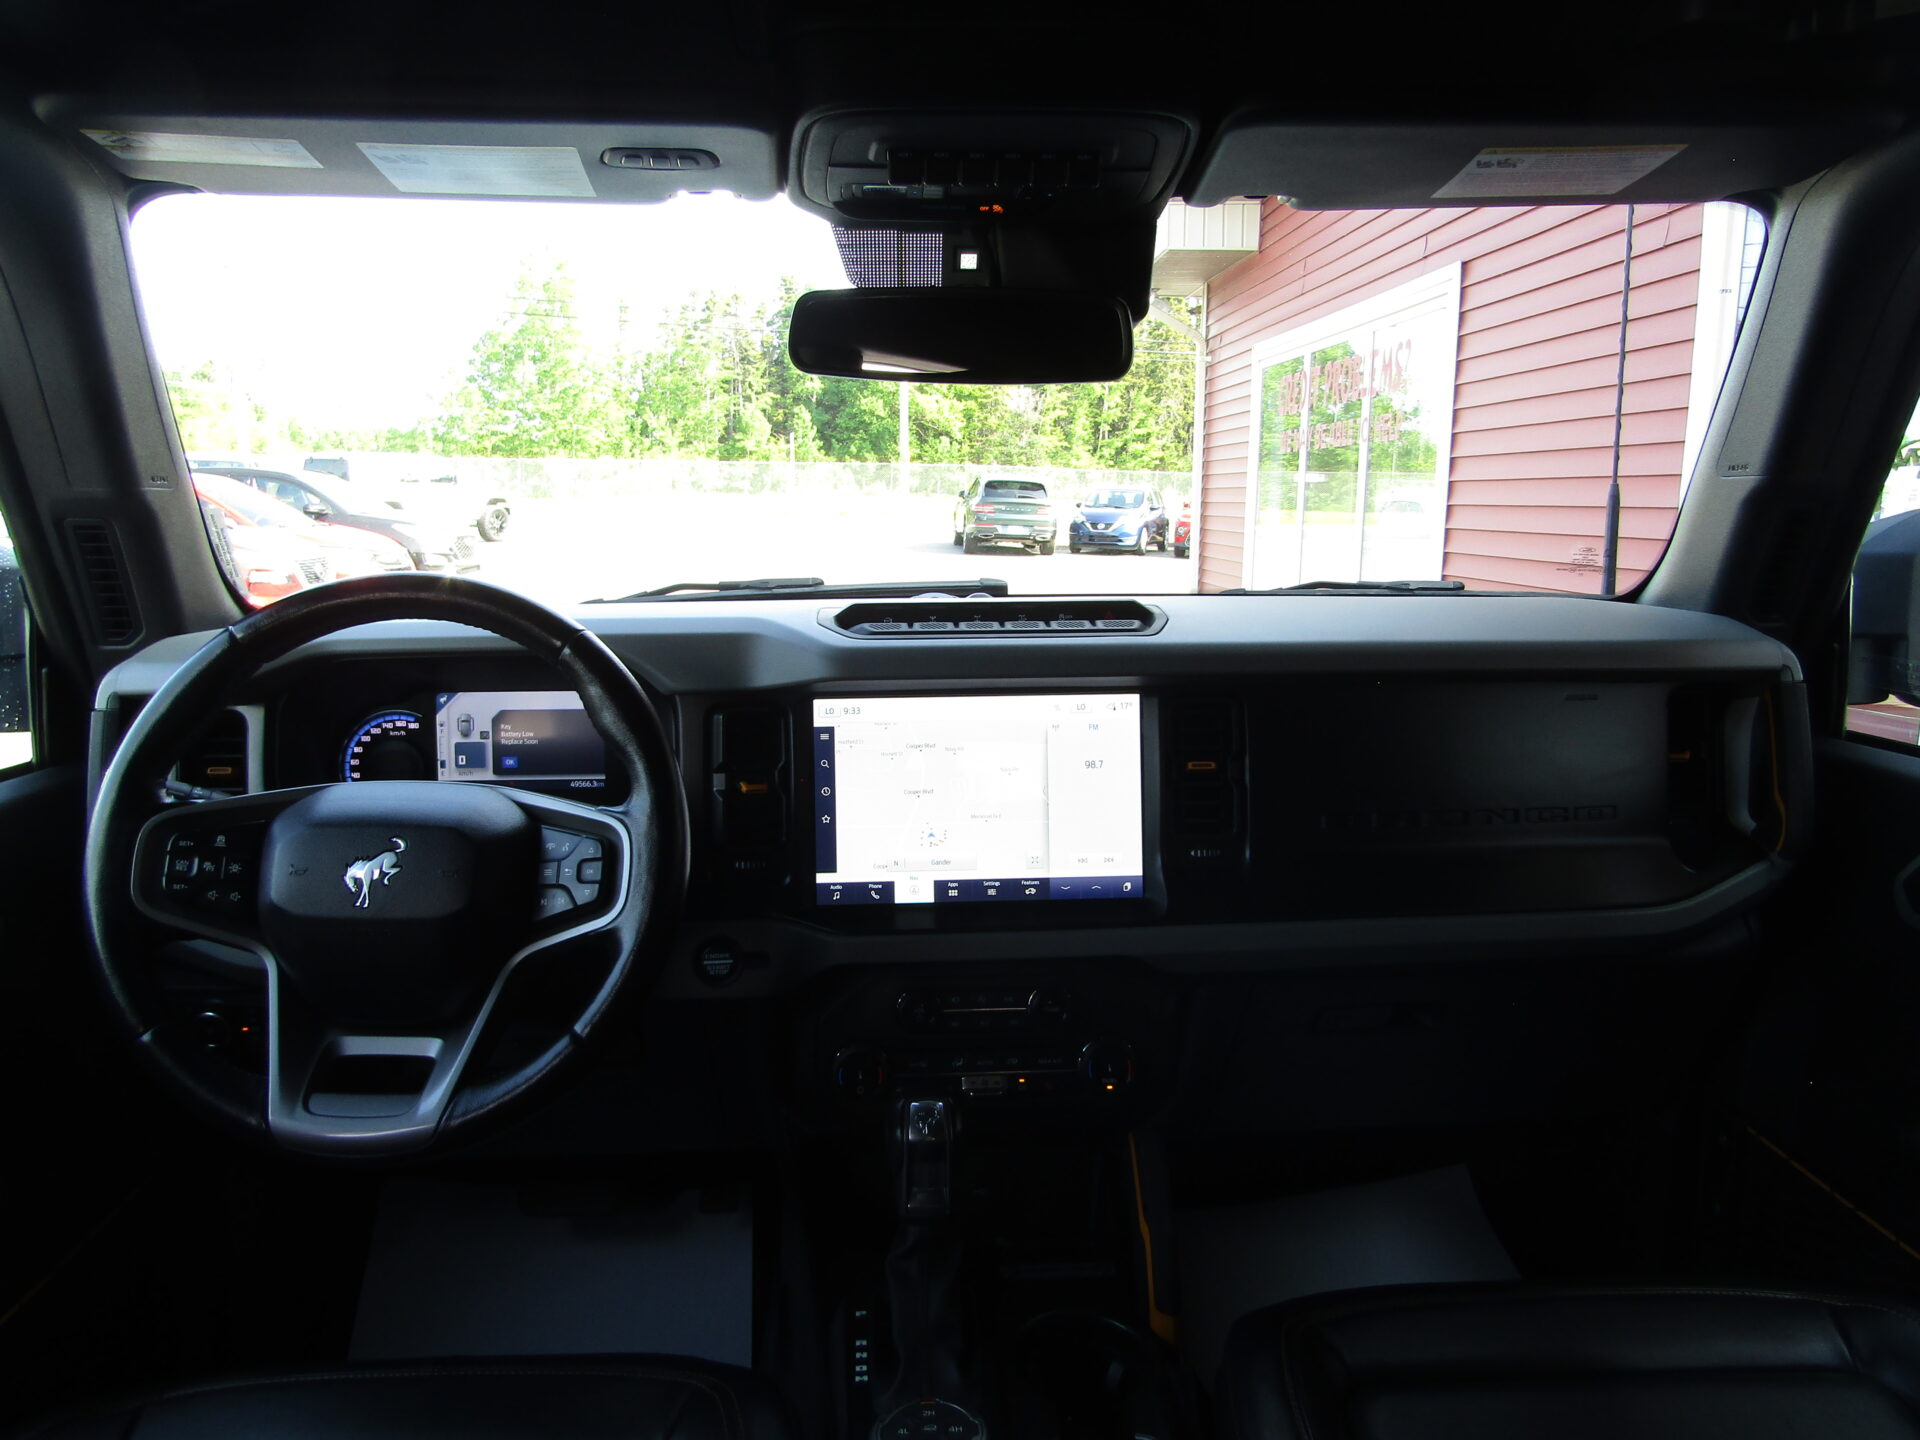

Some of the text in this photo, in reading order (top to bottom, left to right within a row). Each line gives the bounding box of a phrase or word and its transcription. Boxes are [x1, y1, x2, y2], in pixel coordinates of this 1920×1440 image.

[825, 707, 861, 715] LO 9:33
[1076, 703, 1086, 711] LO
[1088, 723, 1099, 731] FM
[1084, 760, 1104, 769] 98.7
[931, 858, 952, 866] Gander
